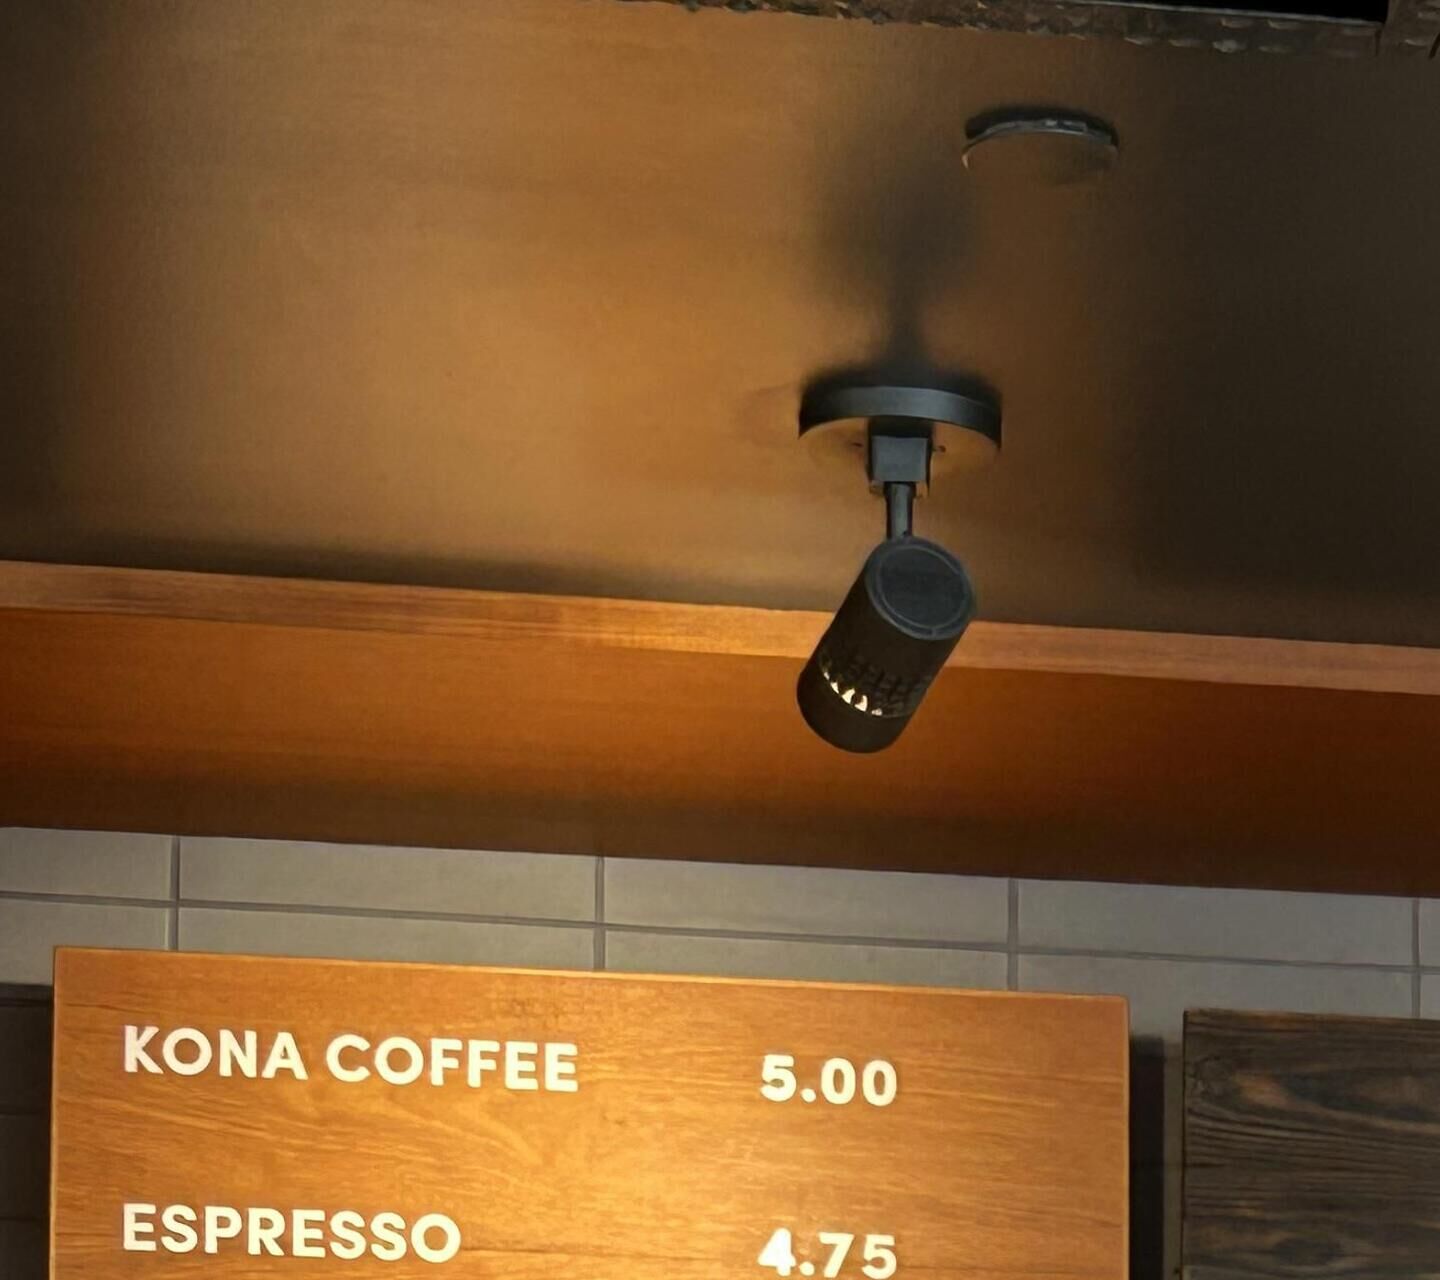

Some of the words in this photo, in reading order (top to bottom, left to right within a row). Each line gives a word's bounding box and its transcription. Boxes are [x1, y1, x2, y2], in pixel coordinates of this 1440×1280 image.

[124, 1025, 308, 1080] KONA
[325, 1034, 578, 1093] COFFEE
[760, 1053, 897, 1107] 5.00
[123, 1203, 462, 1263] ESPRESSO
[757, 1227, 897, 1280] 4.75
